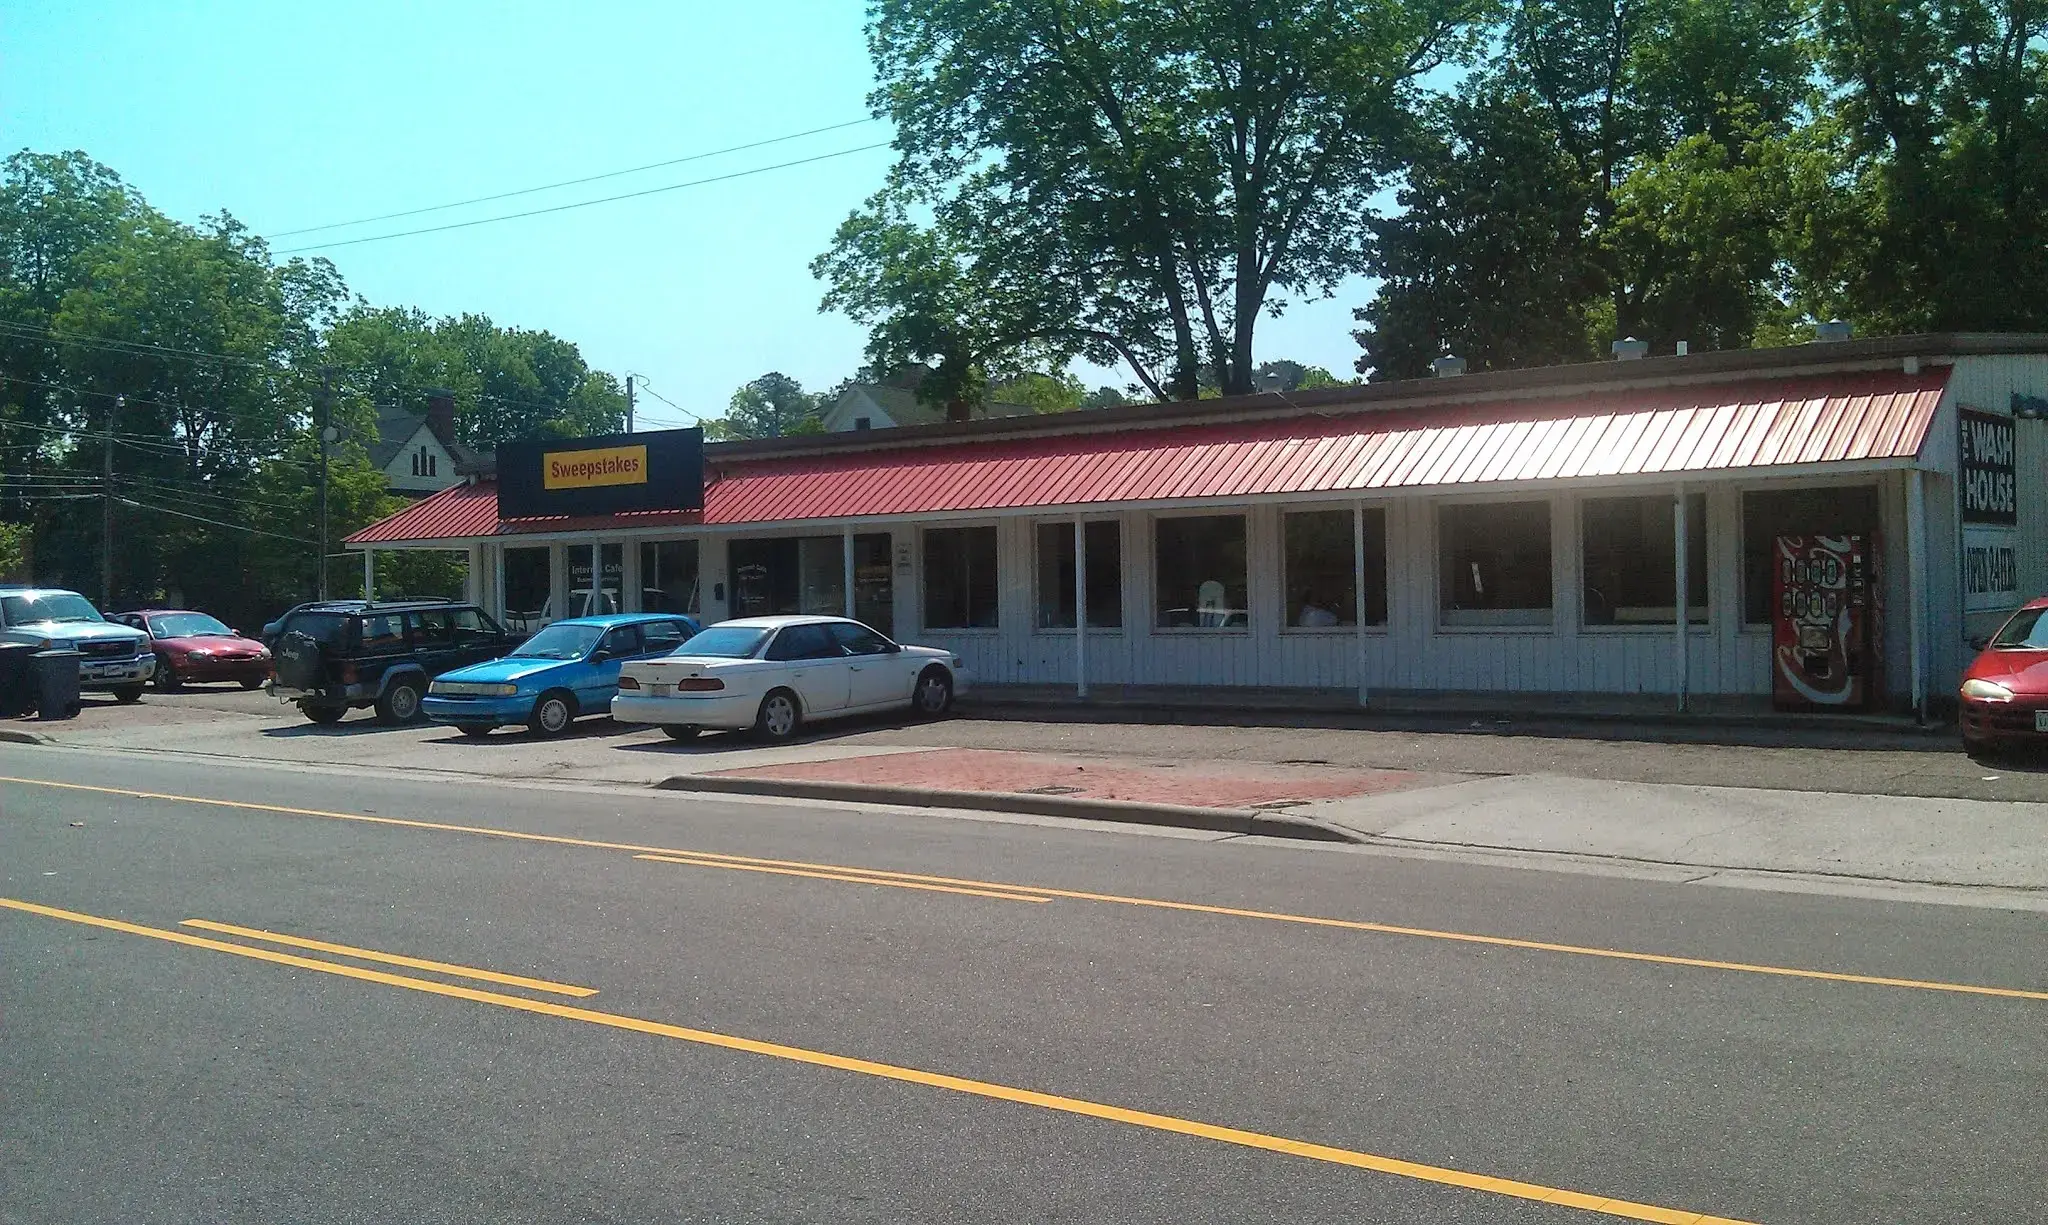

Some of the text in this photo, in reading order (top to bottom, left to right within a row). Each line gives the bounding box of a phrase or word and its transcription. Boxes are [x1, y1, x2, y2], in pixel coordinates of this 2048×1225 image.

[1971, 419, 2013, 466] WASH
[551, 456, 640, 480] Sweepstakes
[1965, 467, 2014, 512] HOUSE
[1967, 546, 1988, 593] OPEN
[281, 647, 299, 661] Jeep
